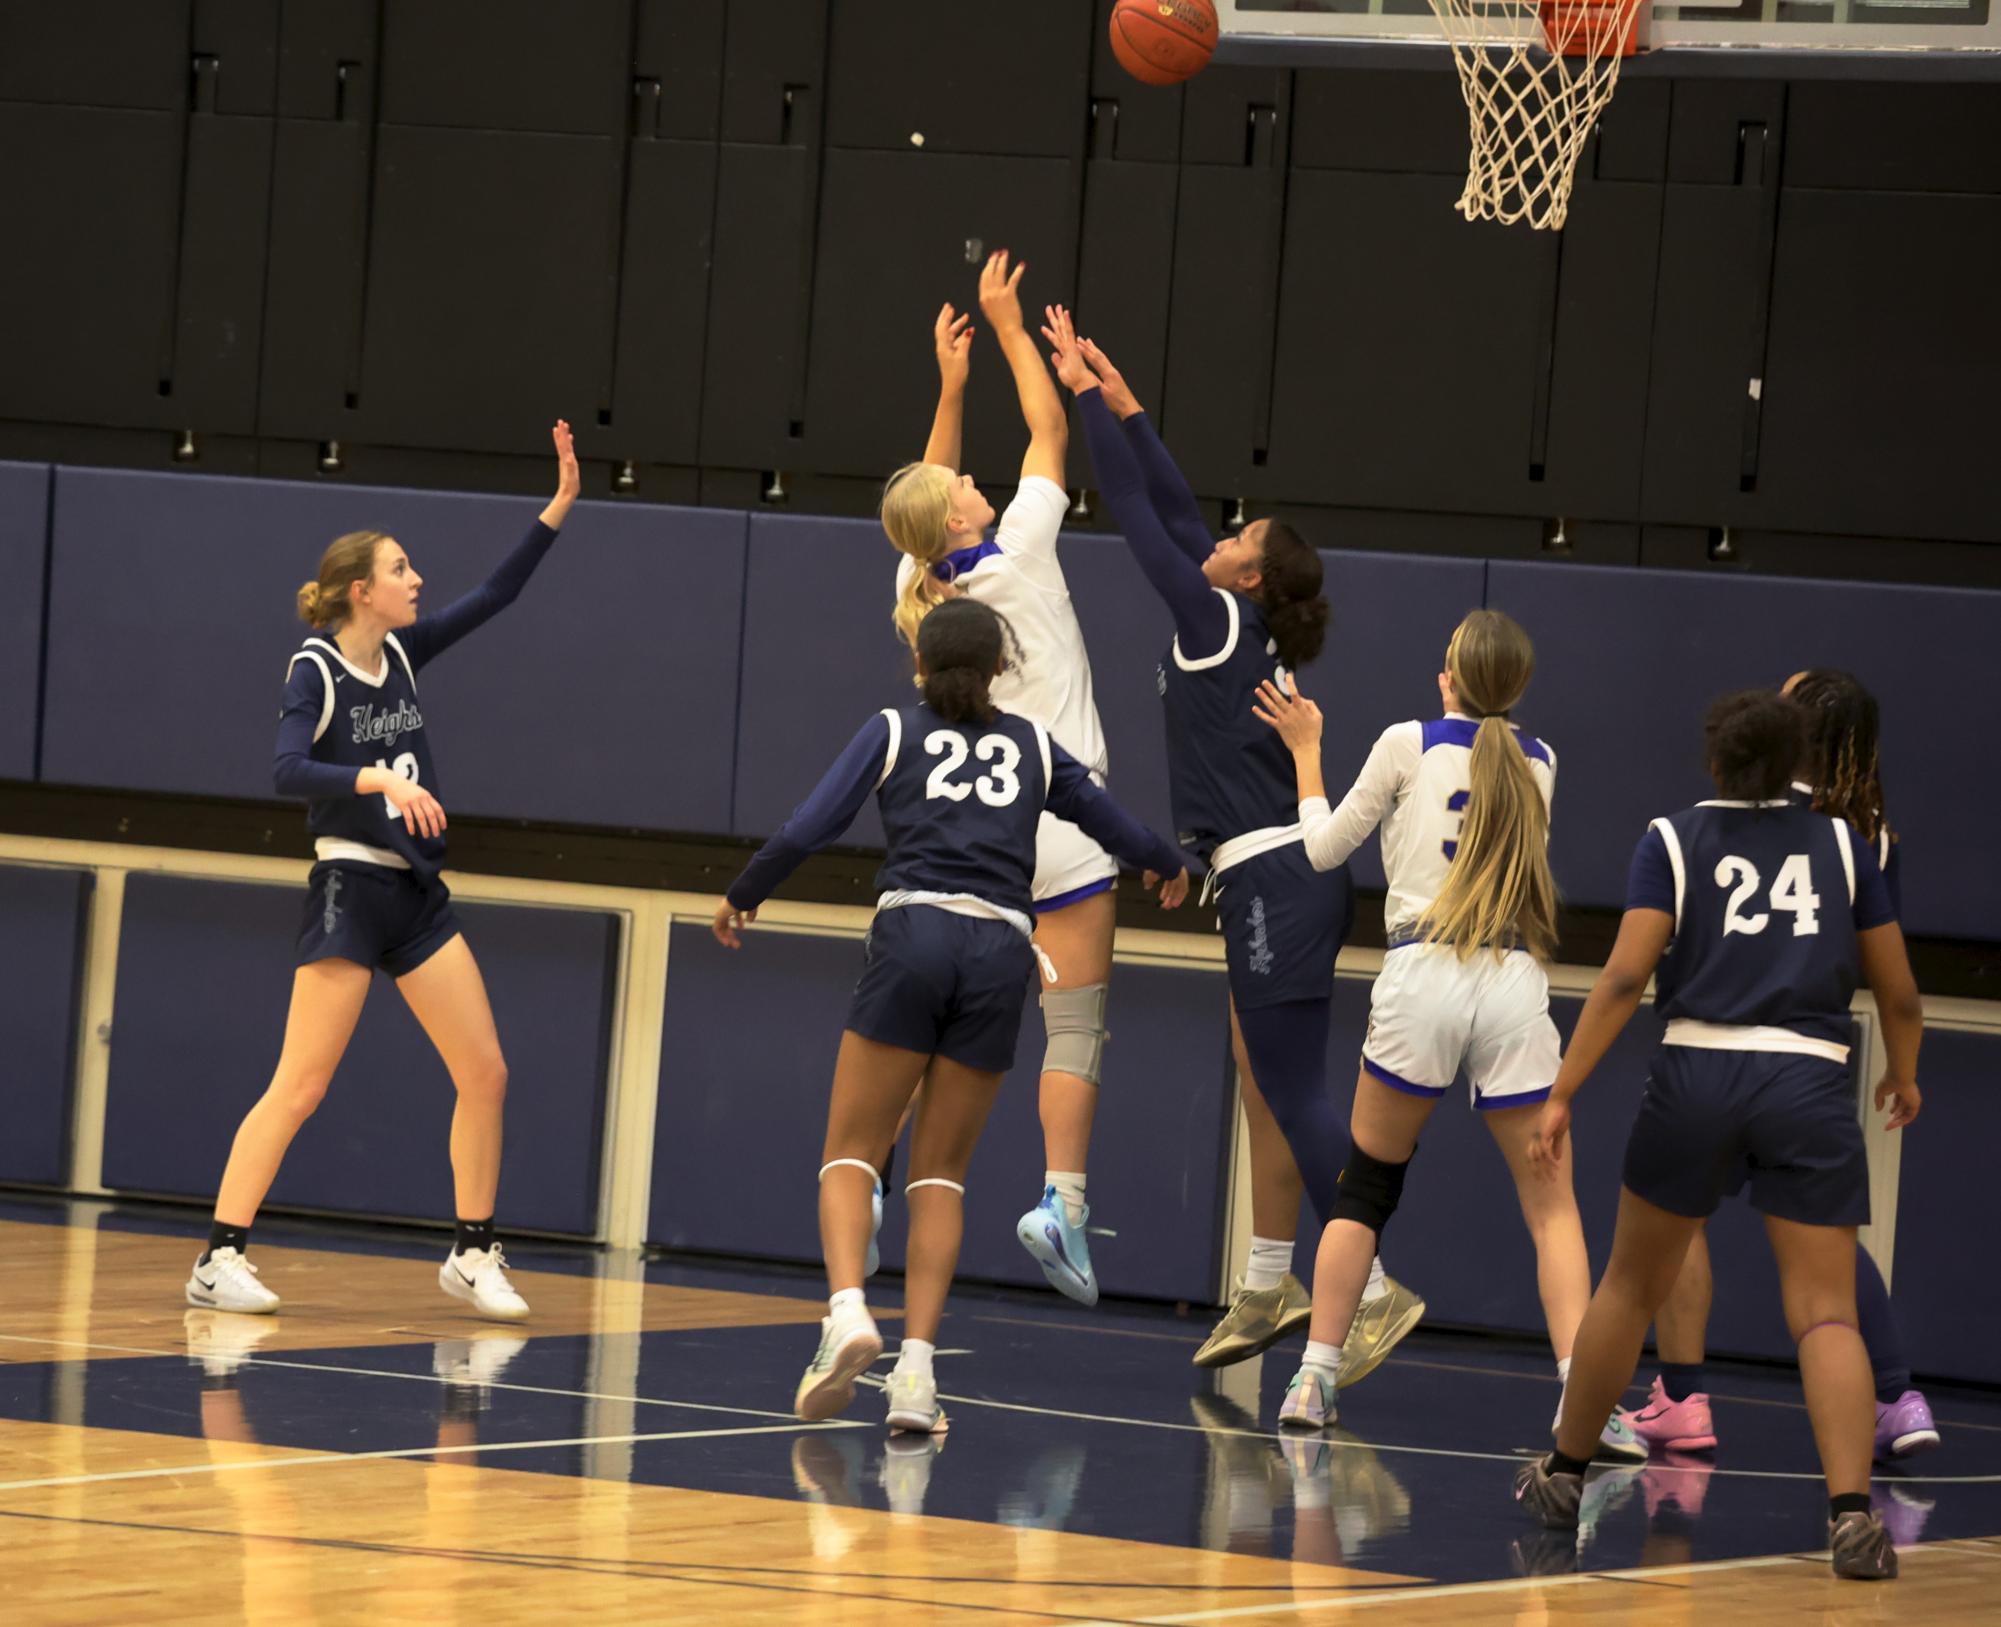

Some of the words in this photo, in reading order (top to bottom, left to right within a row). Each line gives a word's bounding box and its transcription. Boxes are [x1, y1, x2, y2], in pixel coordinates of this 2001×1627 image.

[350, 698, 424, 747] Heights
[924, 729, 1022, 807] 23
[1714, 854, 1820, 938] 24
